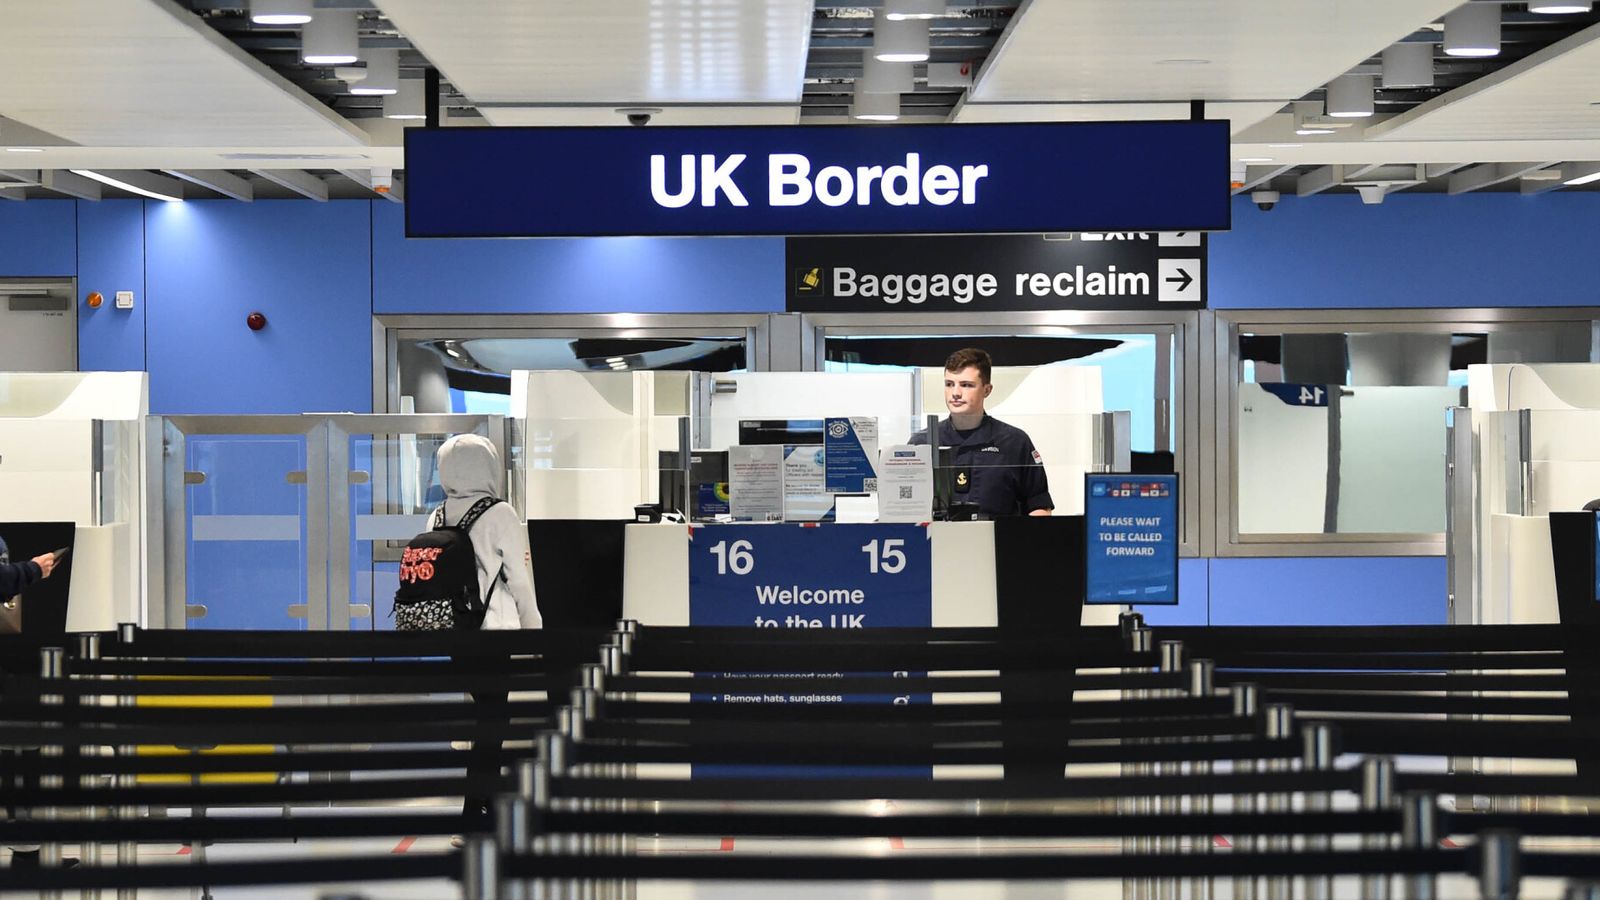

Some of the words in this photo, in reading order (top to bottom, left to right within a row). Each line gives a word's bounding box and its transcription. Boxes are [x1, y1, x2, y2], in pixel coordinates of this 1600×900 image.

[650, 153, 749, 208] UK
[768, 152, 989, 207] Border
[833, 267, 998, 304] Baggage
[1015, 264, 1150, 298] reclaim
[1100, 517, 1134, 526] PLEASE
[1135, 517, 1161, 526] WAIT
[1099, 532, 1112, 542] TO
[1114, 532, 1126, 542] BE
[1127, 532, 1162, 542] CALLED
[709, 539, 754, 575] 16
[862, 539, 907, 574] 15
[1106, 546, 1155, 556] FORWARD
[755, 585, 865, 605] Welcome
[754, 615, 779, 628] to
[784, 614, 823, 628] the
[830, 614, 866, 628] UK
[723, 694, 761, 703] Remove
[763, 694, 787, 704] hats,
[789, 694, 843, 704] sunglasses
